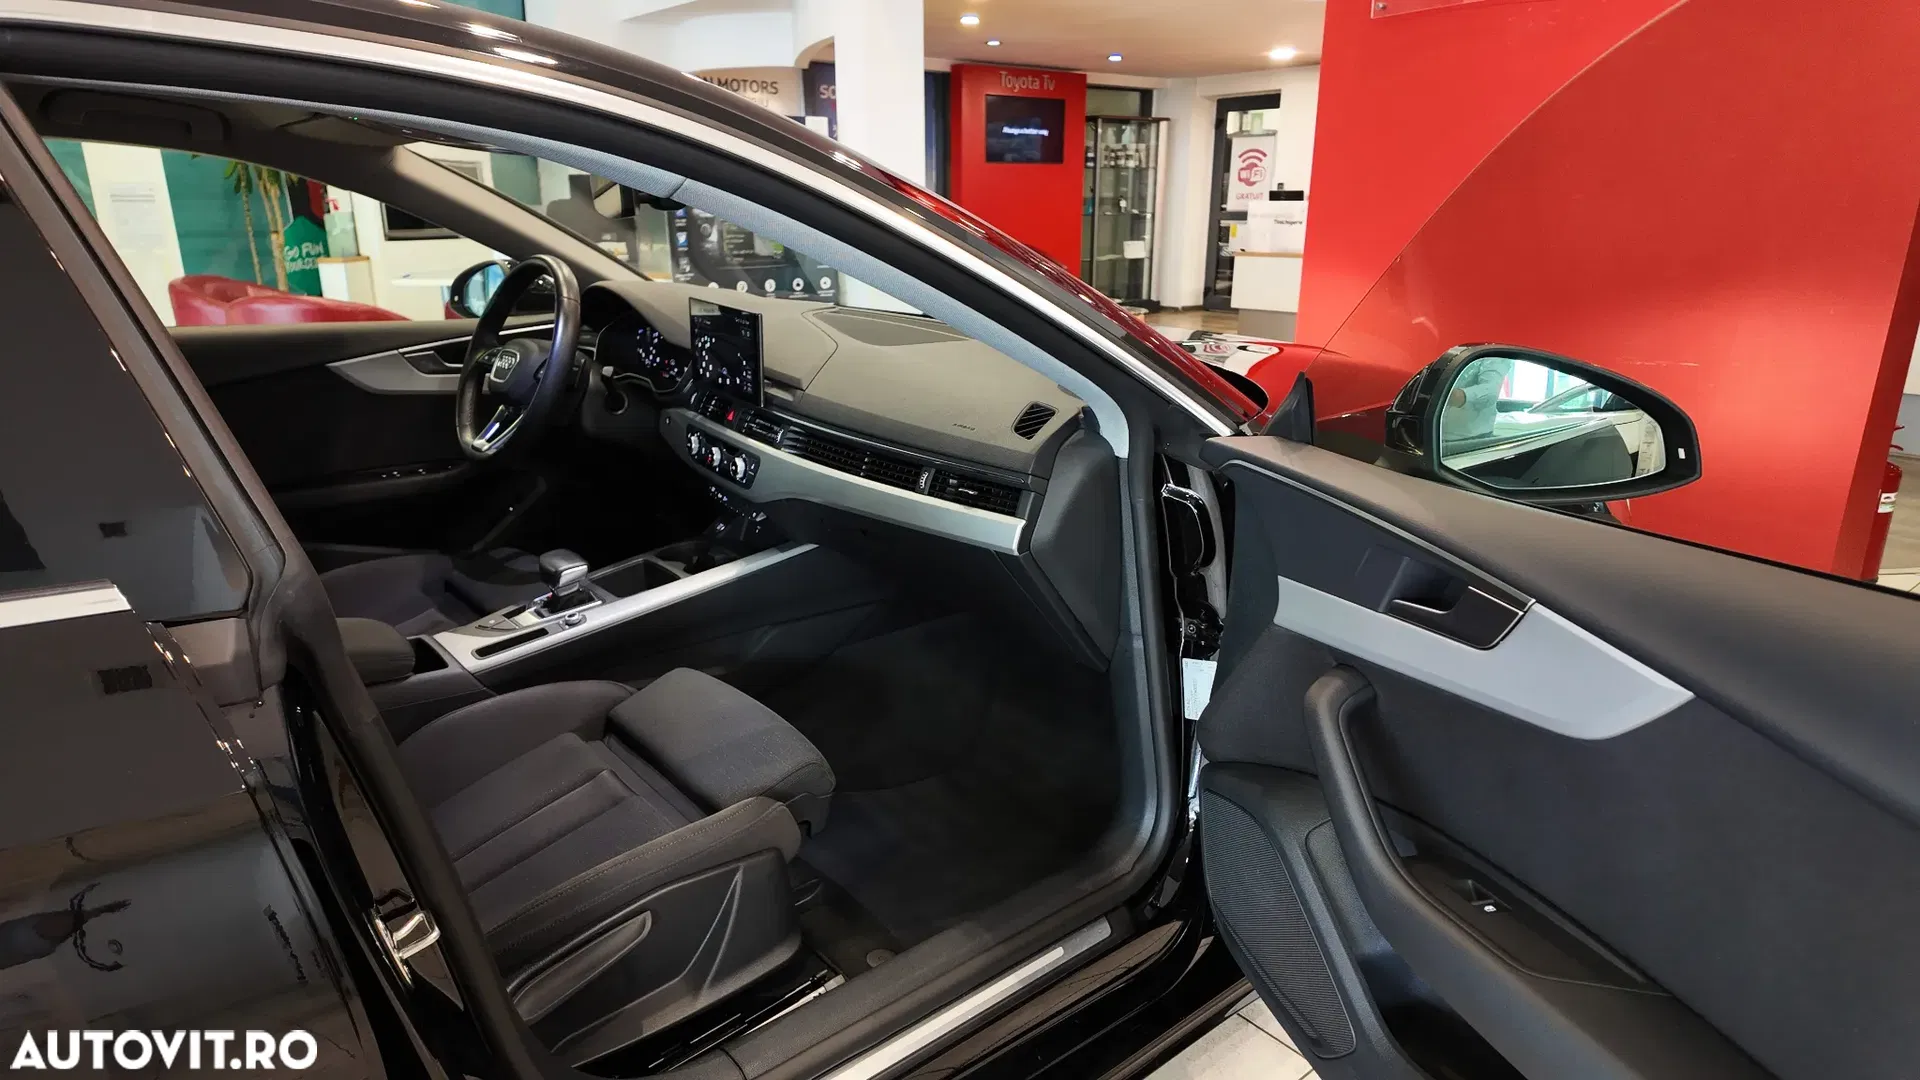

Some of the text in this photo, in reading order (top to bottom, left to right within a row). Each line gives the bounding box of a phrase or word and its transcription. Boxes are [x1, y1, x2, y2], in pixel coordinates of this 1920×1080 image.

[719, 78, 779, 95] MOTORS
[999, 71, 1056, 93] Toyota Tv
[1236, 192, 1264, 200] GRATUIT
